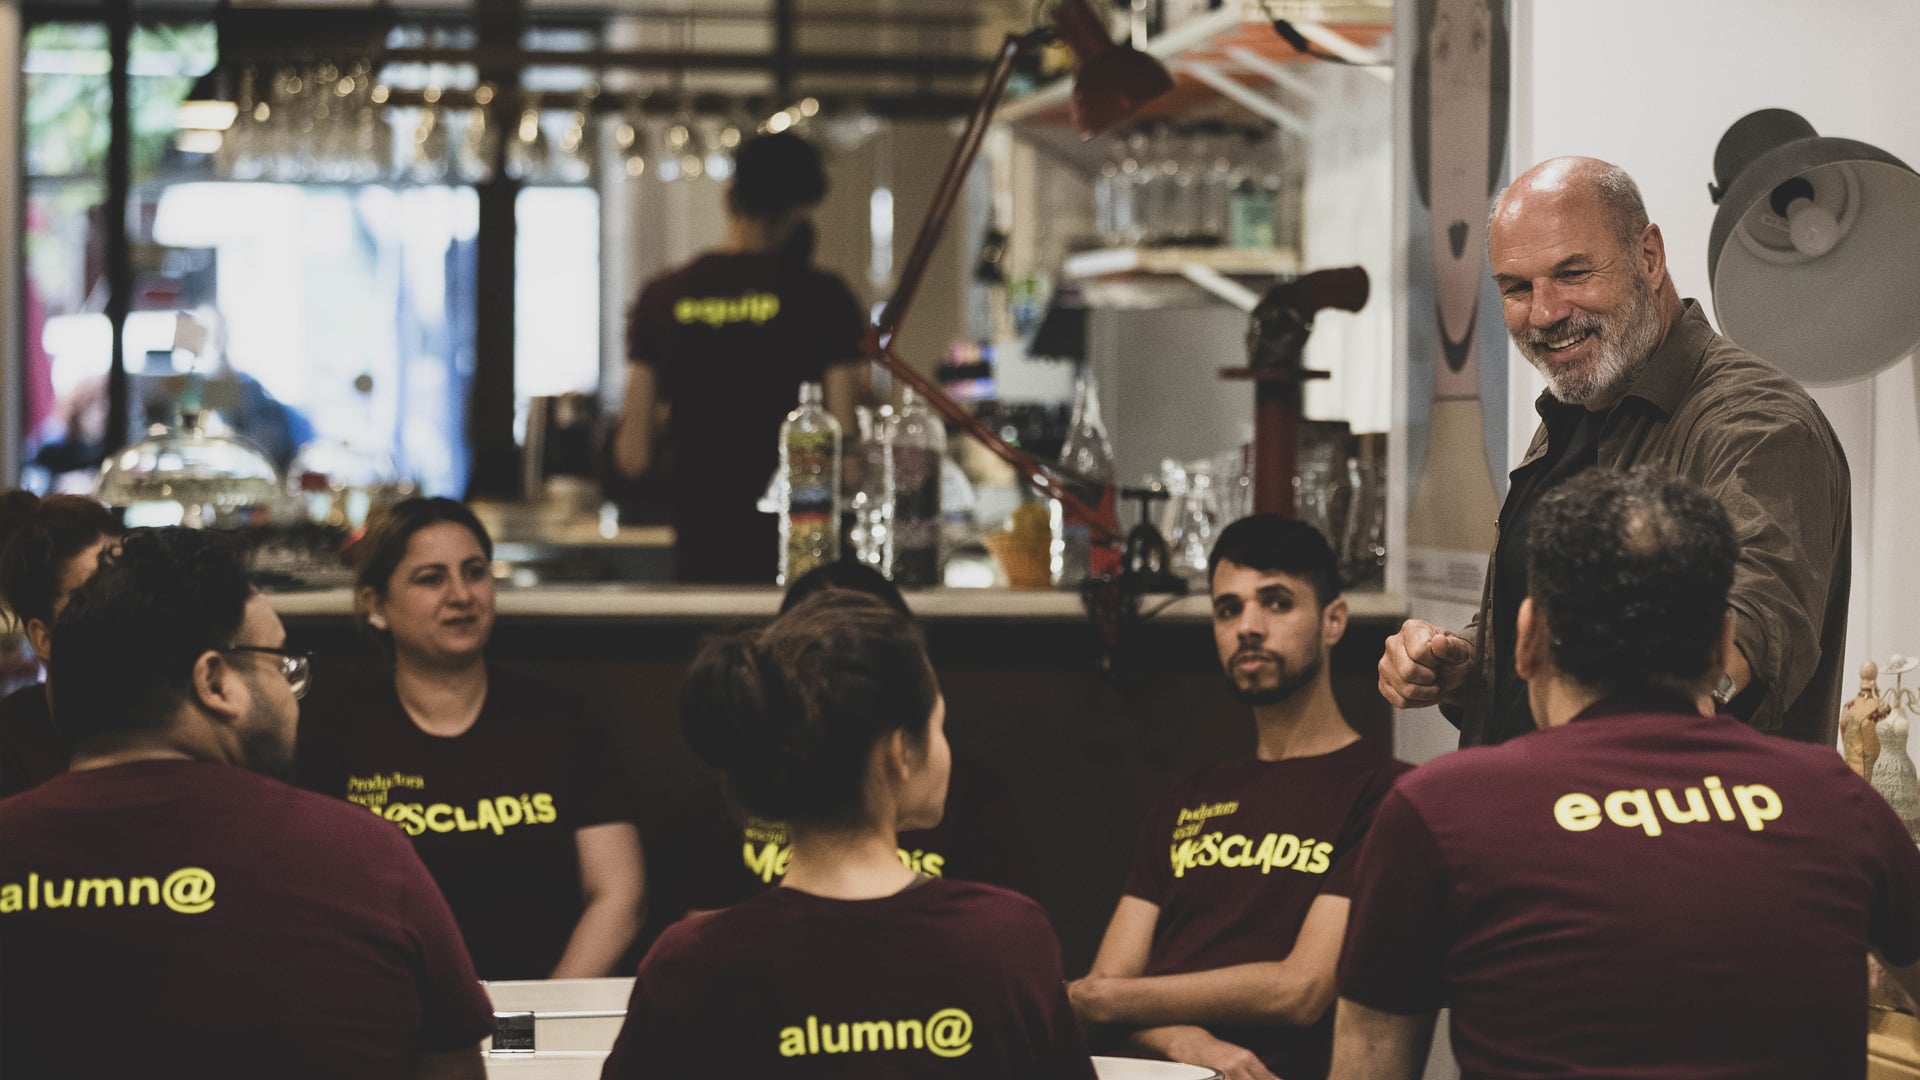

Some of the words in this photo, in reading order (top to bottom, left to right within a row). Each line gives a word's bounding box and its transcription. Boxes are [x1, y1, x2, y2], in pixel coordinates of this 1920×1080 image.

[675, 293, 780, 328] equip
[1554, 777, 1783, 838] equip
[0, 867, 217, 915] alumn@
[779, 1008, 974, 1058] alumn@
